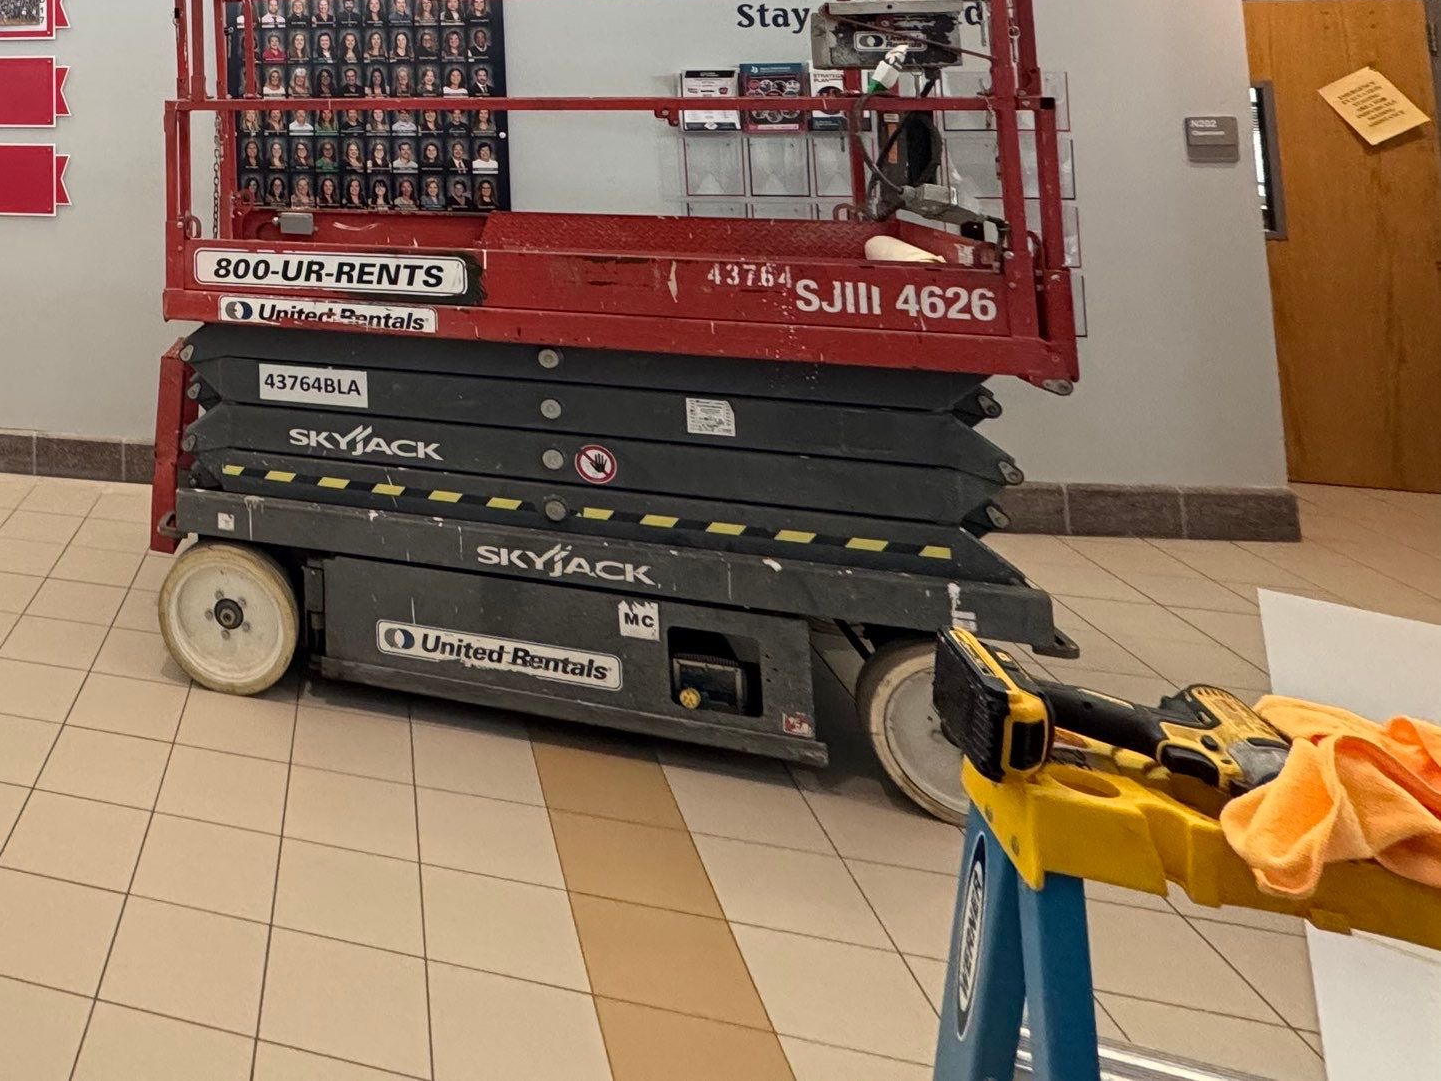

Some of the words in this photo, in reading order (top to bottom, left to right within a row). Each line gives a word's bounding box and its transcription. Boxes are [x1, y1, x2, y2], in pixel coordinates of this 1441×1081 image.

[737, 3, 810, 34] Stay
[213, 257, 445, 288] 800-UR-RENTS
[707, 262, 792, 288] 43764
[795, 278, 881, 315] SJIII
[895, 284, 998, 321] 4626
[258, 303, 336, 323] United
[339, 307, 425, 331] Rentals
[264, 373, 361, 396] 43764BLA
[288, 424, 444, 461] SKYJACK
[476, 543, 658, 586] SKYJACK
[420, 632, 504, 665] United
[510, 646, 610, 681] Rentals
[960, 868, 982, 999] WERNER
